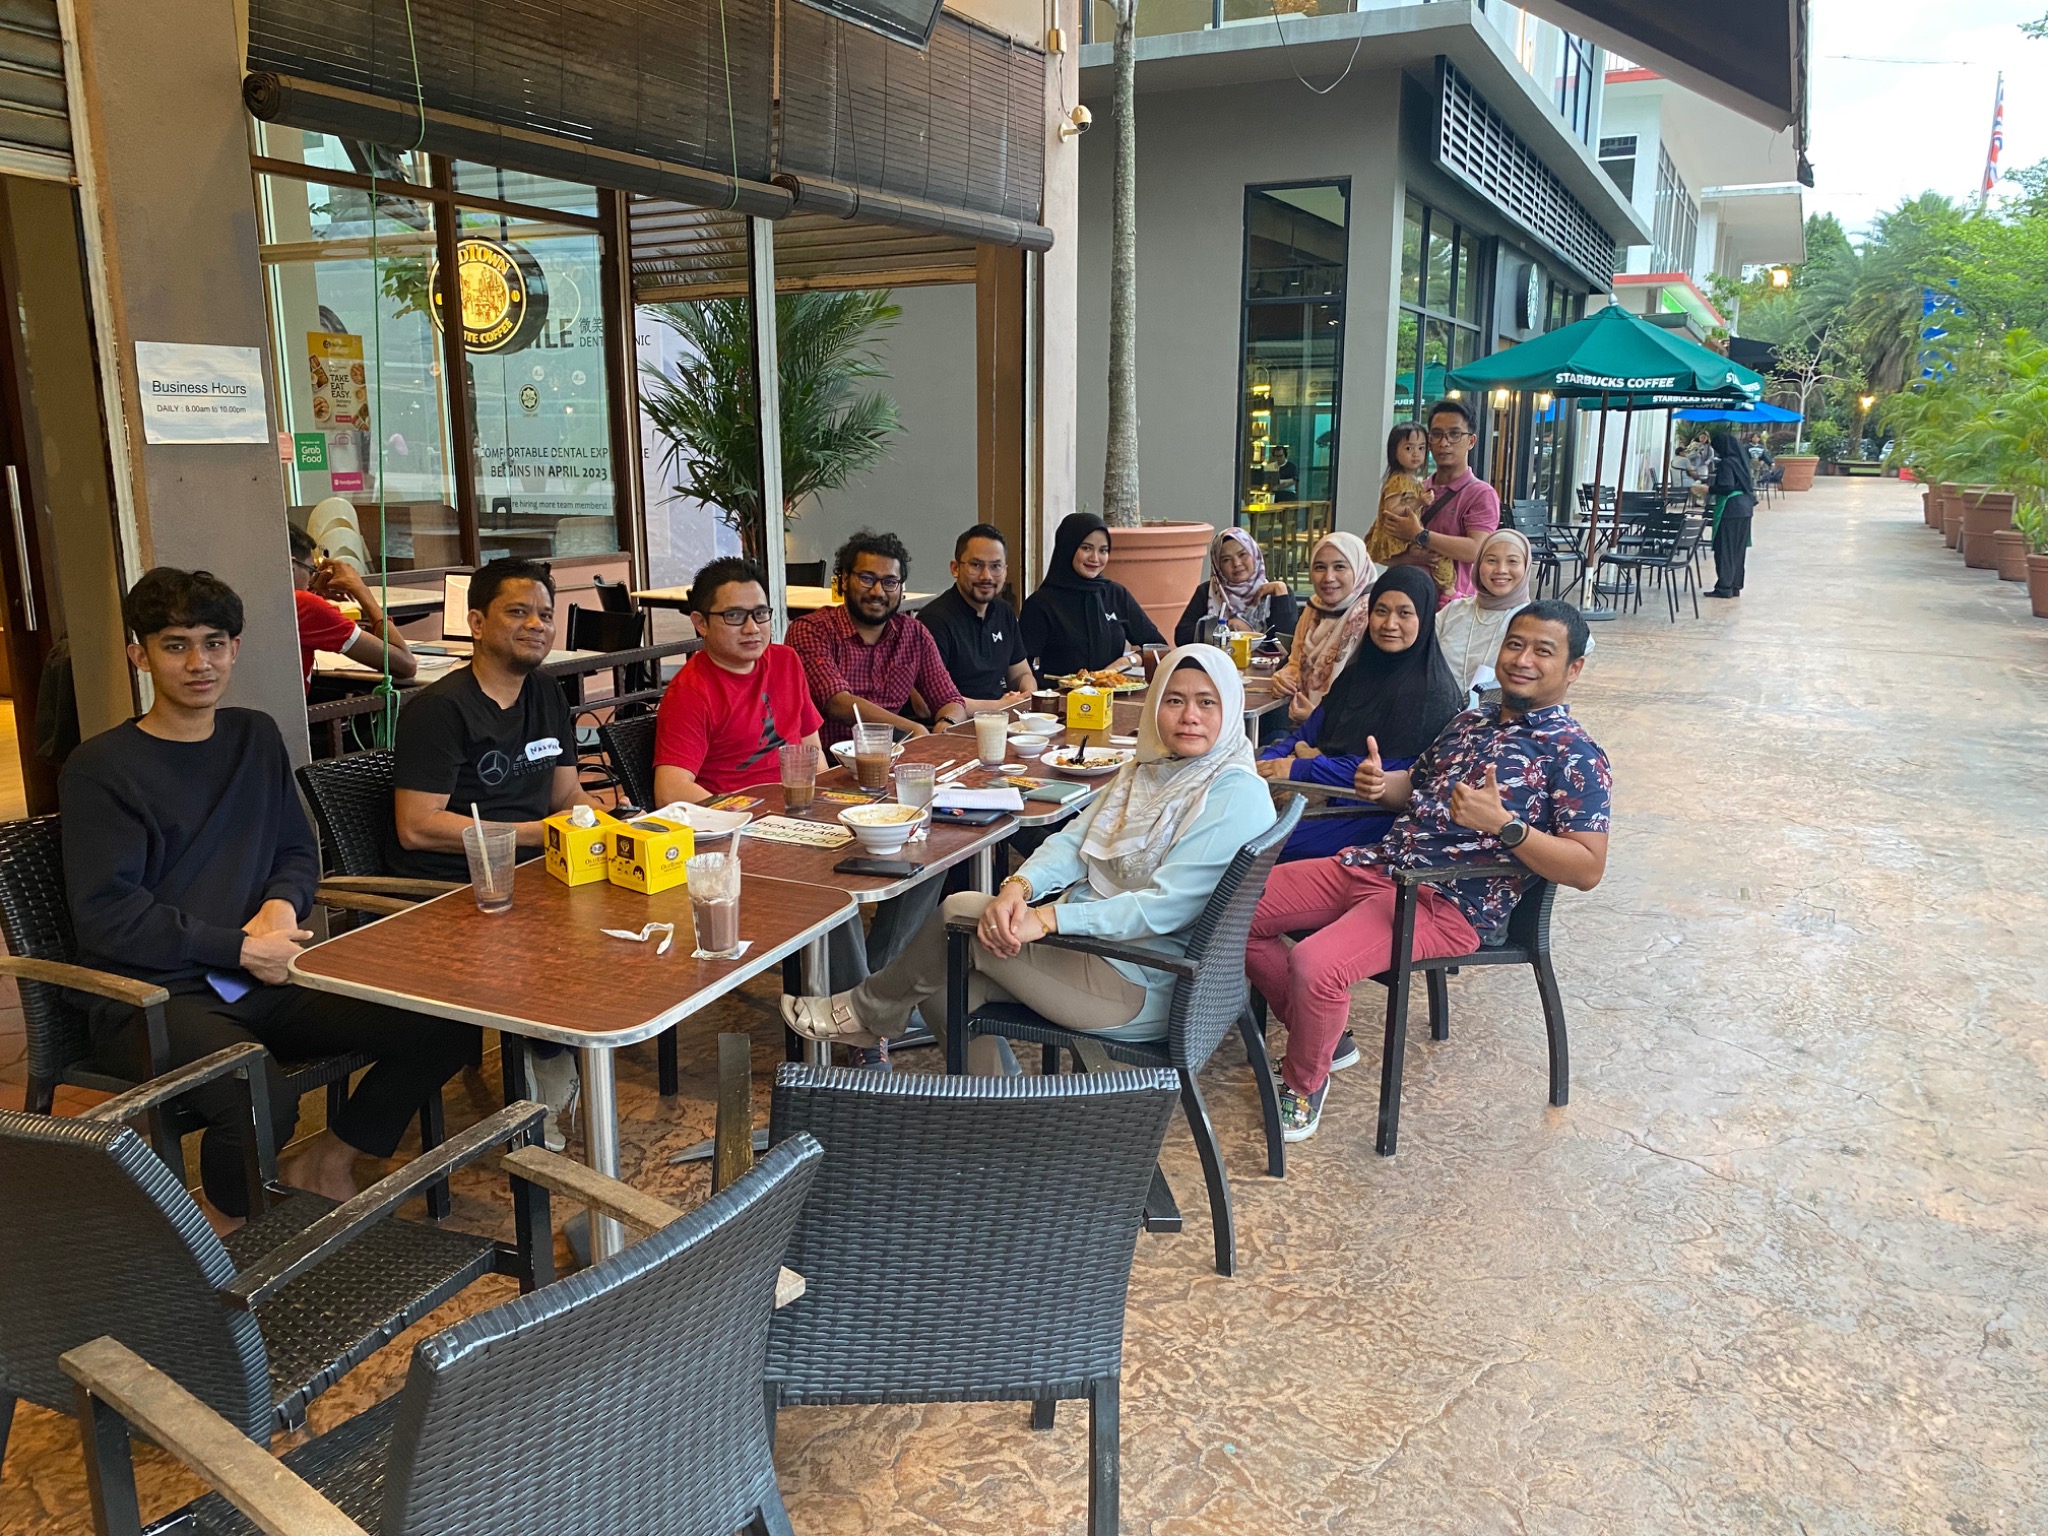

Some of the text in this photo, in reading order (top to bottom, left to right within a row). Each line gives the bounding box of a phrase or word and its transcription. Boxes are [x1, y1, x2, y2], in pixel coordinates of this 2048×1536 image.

[458, 245, 510, 275] DTOWN
[464, 331, 479, 343] ITE
[480, 318, 513, 343] COFFEE
[580, 336, 604, 347] DENT
[330, 374, 349, 382] TAKE
[1556, 373, 1675, 388] STARBUCKS COFFEE
[152, 380, 247, 394] Business Hours
[330, 382, 345, 390] EAT
[219, 405, 246, 414] 10.00pm
[301, 445, 321, 454] Grab
[551, 447, 588, 458] DENTAL
[302, 454, 322, 463] Food
[534, 466, 545, 478] IN
[549, 466, 580, 478] APRIL
[583, 467, 608, 481] 2023
[520, 500, 538, 510] hiring
[755, 821, 814, 833] PICK-UP
[794, 822, 834, 830] FOOD
[742, 827, 843, 845] GrabFood
